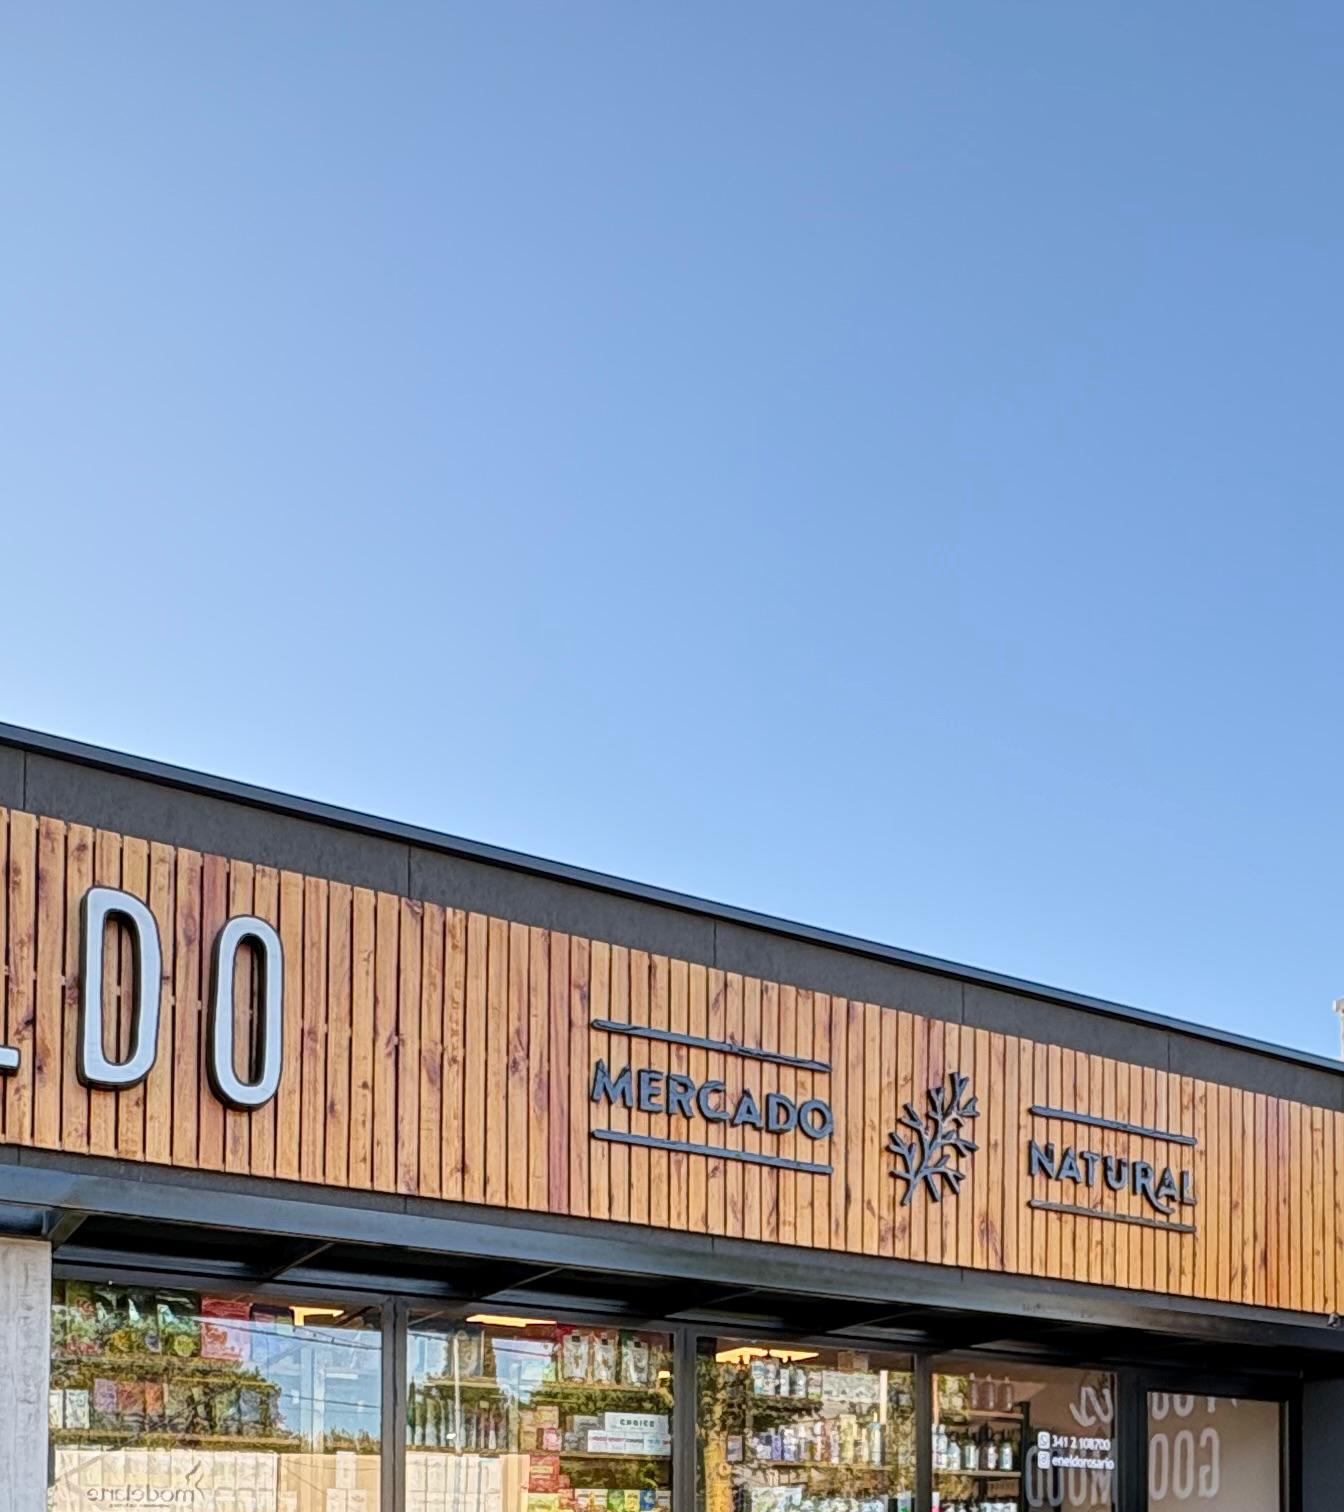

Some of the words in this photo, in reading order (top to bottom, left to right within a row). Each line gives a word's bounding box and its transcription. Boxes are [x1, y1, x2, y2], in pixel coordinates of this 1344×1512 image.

[591, 1059, 834, 1141] MERCADO
[1028, 1138, 1197, 1215] NATURAL
[1052, 1454, 1114, 1470] eneldorosario
